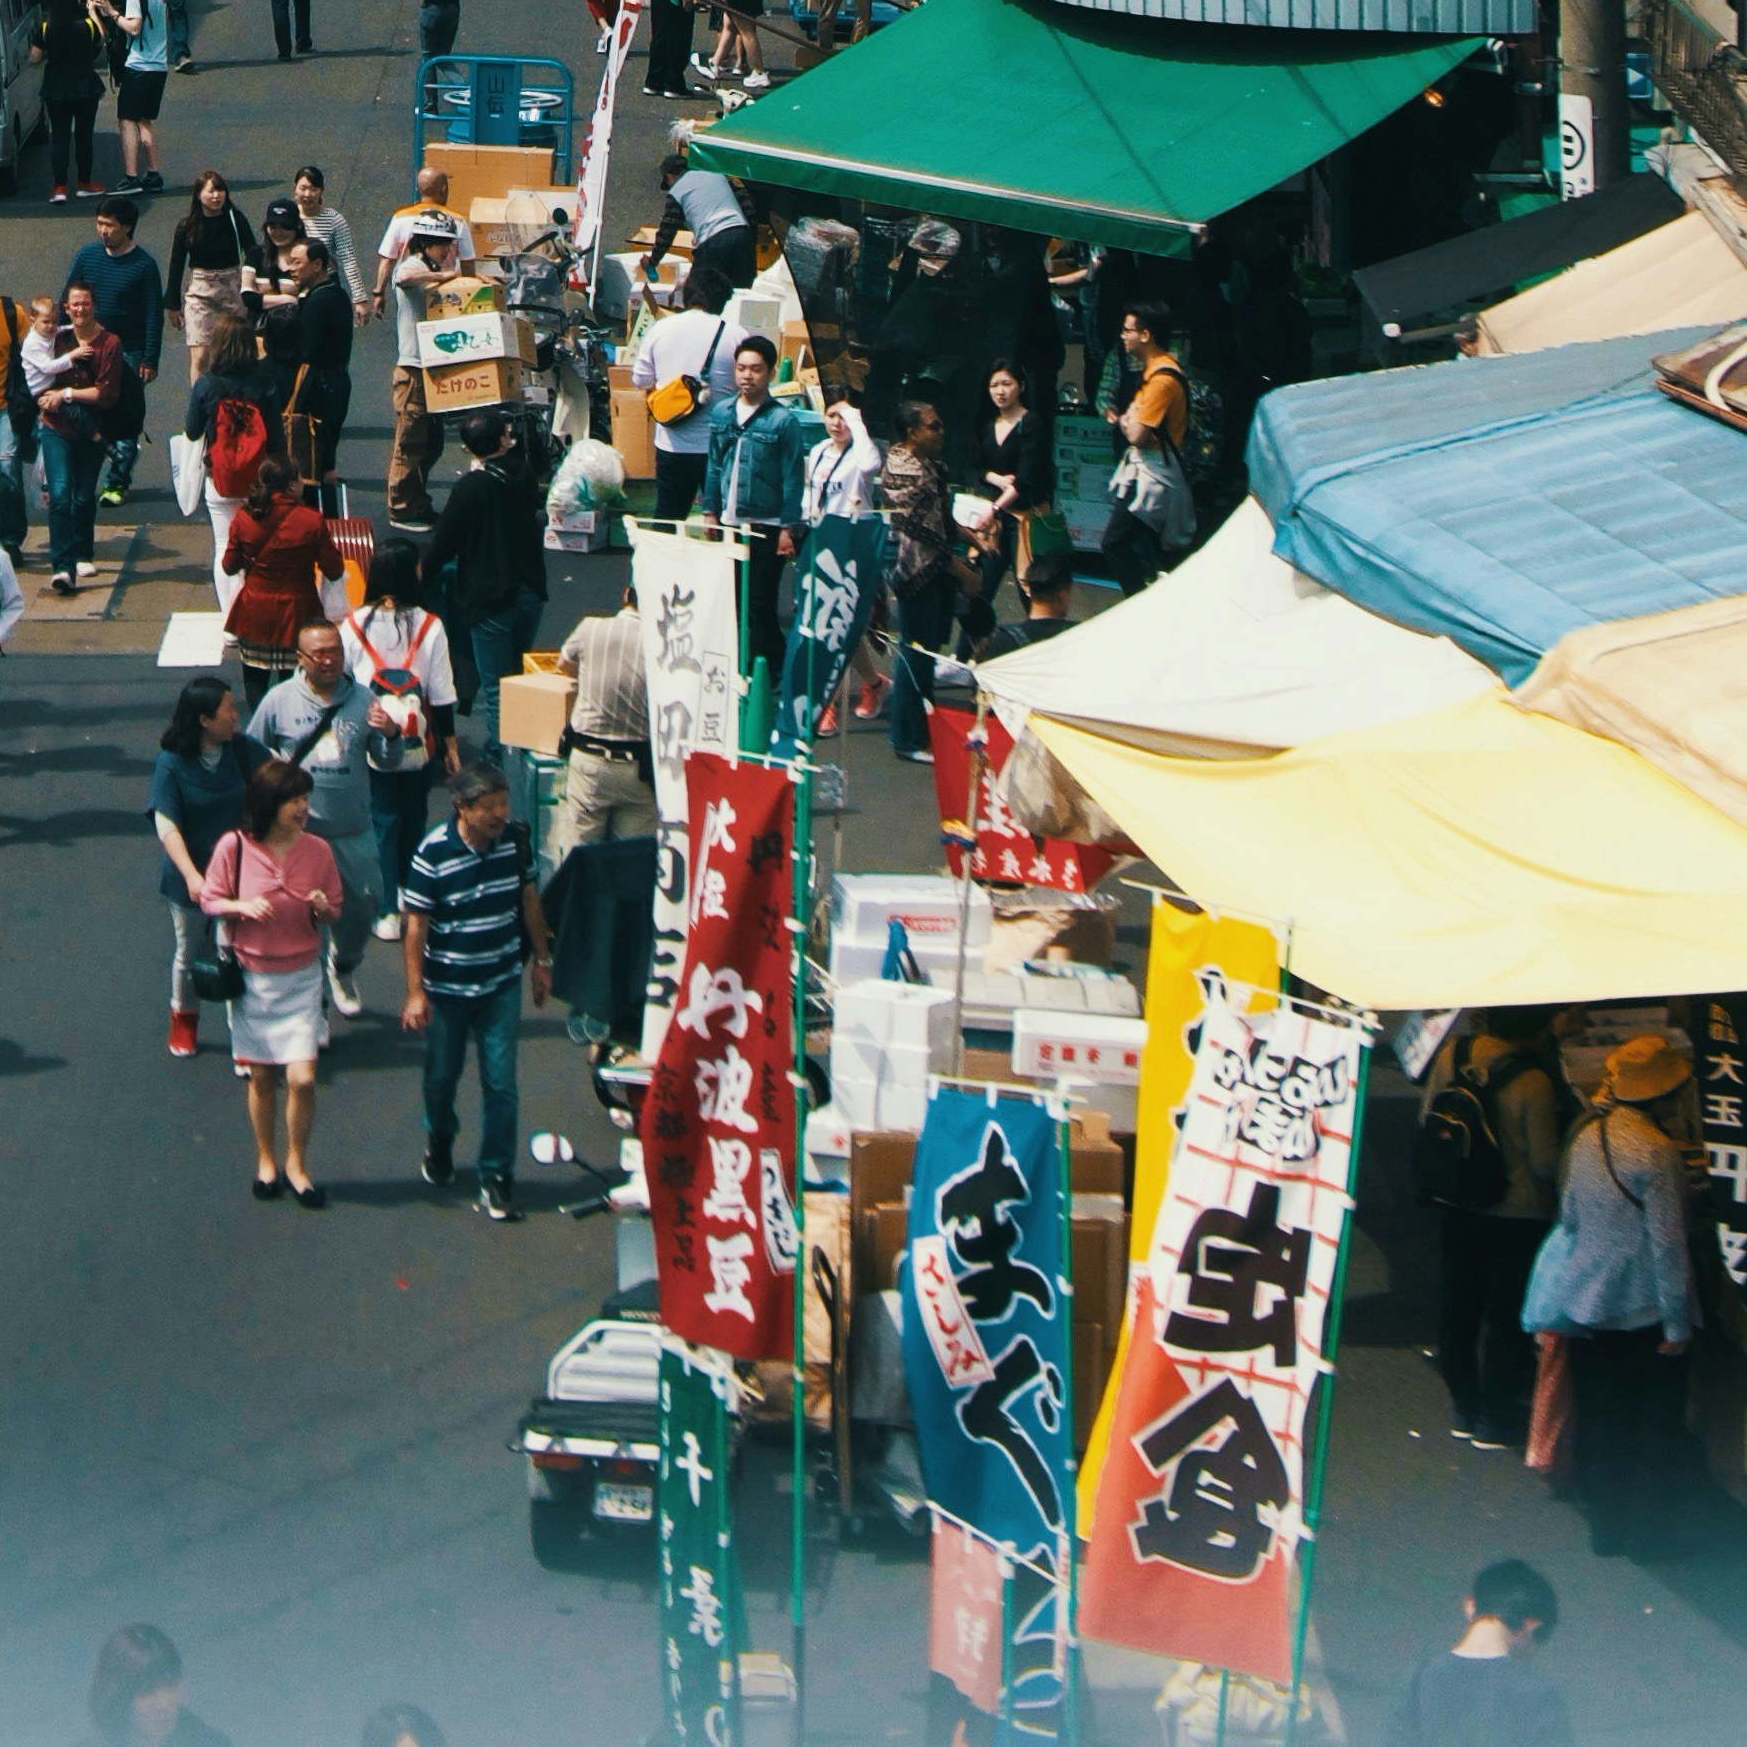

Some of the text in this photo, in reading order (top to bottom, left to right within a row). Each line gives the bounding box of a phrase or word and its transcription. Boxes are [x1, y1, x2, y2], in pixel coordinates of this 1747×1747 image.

[436, 374, 492, 395] たけのこ
[677, 960, 764, 1323] 丹波黒豆
